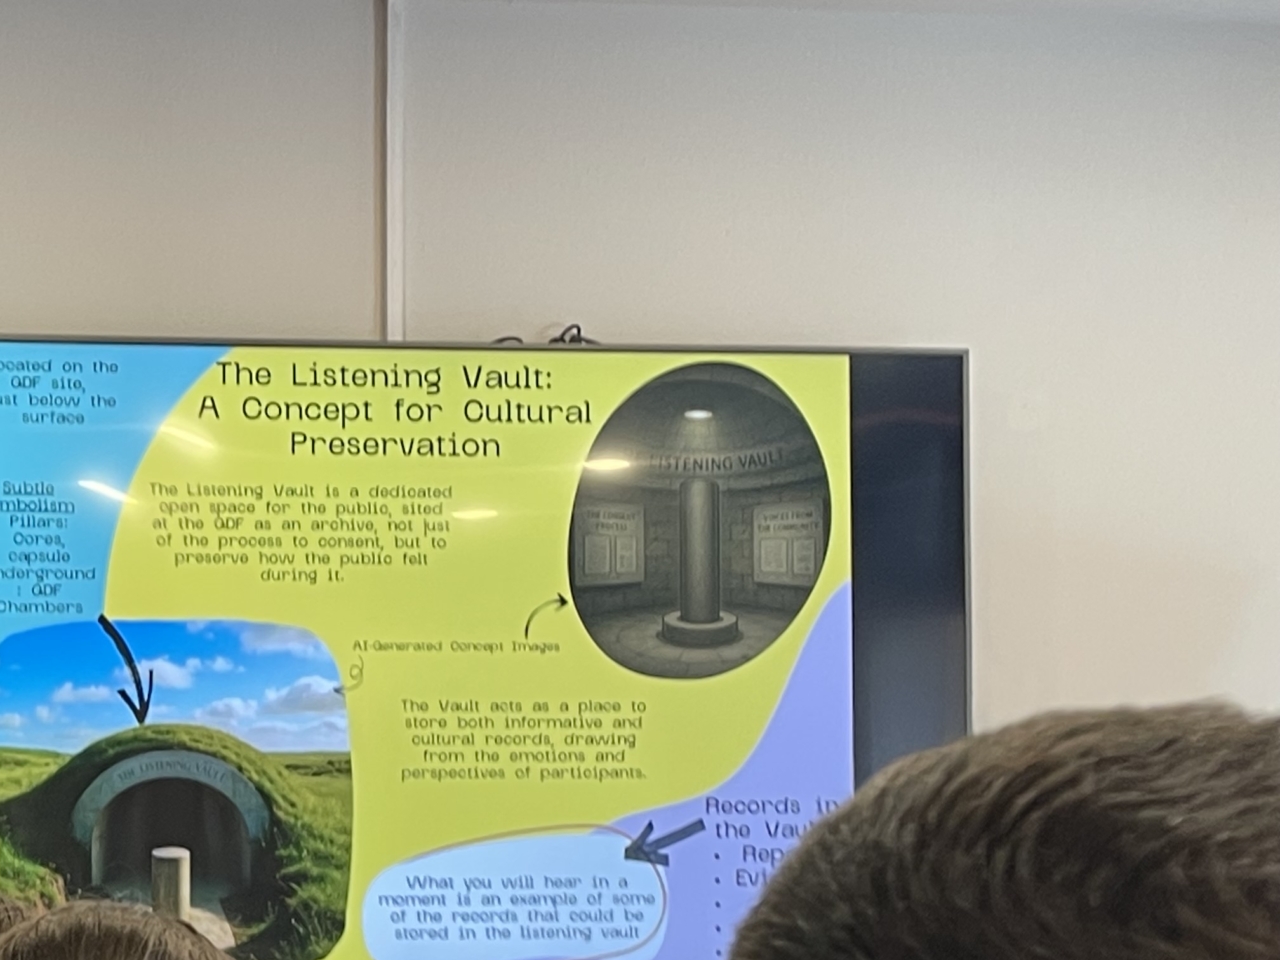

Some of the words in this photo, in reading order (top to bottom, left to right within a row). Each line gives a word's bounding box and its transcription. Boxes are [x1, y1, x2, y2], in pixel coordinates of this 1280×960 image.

[62, 361, 83, 372] on
[93, 361, 119, 373] the
[51, 377, 85, 394] site,
[216, 361, 272, 387] The
[291, 362, 441, 395] Listening
[462, 364, 553, 390] Vault:
[29, 393, 80, 407] below
[91, 395, 116, 407] the
[22, 411, 84, 424] surface
[198, 395, 220, 419] A
[242, 396, 373, 429] Concept
[394, 398, 442, 422] for
[463, 399, 592, 424] Cultural
[291, 431, 501, 457] Preservation
[739, 450, 784, 469] VAULT
[2, 481, 54, 496] Subtle
[150, 482, 178, 496] The
[187, 483, 263, 500] Listening
[273, 484, 314, 497] Vault
[326, 484, 339, 498] is
[350, 487, 359, 498] a
[369, 485, 452, 498] dedicated
[159, 501, 200, 517] open
[210, 502, 255, 517] space
[266, 502, 290, 513] for
[301, 502, 326, 515] the
[336, 502, 392, 518] public,
[402, 502, 443, 515] sited
[10, 515, 68, 528] Pillars:
[153, 518, 168, 530] at
[179, 517, 204, 530] the
[255, 519, 271, 530] as
[281, 520, 301, 530] an
[311, 518, 377, 535] archive,
[388, 520, 413, 531] not
[424, 519, 450, 537] just
[13, 532, 65, 549] Cores,
[156, 533, 172, 547] of
[183, 534, 208, 547] the
[218, 535, 282, 551] process
[293, 536, 308, 548] to
[318, 535, 384, 551] consent,
[394, 535, 421, 548] but
[431, 537, 446, 549] to
[8, 550, 70, 566] capsule
[174, 552, 249, 567] preserve
[259, 551, 295, 564] how
[305, 552, 330, 565] the
[340, 552, 392, 568] public
[403, 552, 428, 565] felt
[261, 569, 317, 585] during
[328, 569, 344, 582] it.
[450, 641, 503, 654] Concept
[512, 641, 560, 654] Images
[401, 699, 429, 712] The
[439, 700, 479, 713] Vault
[490, 701, 522, 713] acts
[533, 702, 549, 713] as
[560, 702, 569, 713] a
[578, 700, 622, 715] place
[632, 701, 646, 713] to
[405, 717, 447, 729] store
[457, 717, 494, 729] both
[505, 716, 602, 729] informative
[613, 717, 642, 729] and
[412, 733, 475, 747] cultural
[485, 734, 554, 748] records,
[564, 733, 636, 748] drawing
[424, 750, 464, 762] from
[474, 751, 499, 763] the
[510, 750, 585, 763] emotions
[595, 751, 625, 763] and
[401, 766, 505, 782] perspectives
[515, 767, 530, 779] of
[540, 767, 646, 782] participants.
[705, 796, 800, 815] Records
[716, 821, 751, 839] the
[406, 876, 454, 890] What
[463, 877, 492, 893] you
[501, 876, 534, 889] will
[544, 876, 582, 889] hear
[592, 876, 609, 889] in
[618, 878, 628, 890] a
[378, 893, 446, 907] moment
[457, 892, 471, 907] is
[481, 894, 501, 907] an
[510, 893, 577, 909] example
[587, 892, 602, 906] of
[613, 894, 655, 906] some
[390, 910, 407, 924] of
[416, 910, 442, 924] the
[452, 910, 518, 924] records
[528, 909, 559, 923] that
[569, 910, 614, 923] could
[624, 910, 644, 923] be
[395, 926, 449, 941] stored
[459, 926, 476, 940] in
[485, 926, 511, 940] the
[520, 926, 592, 943] listening
[602, 926, 640, 940] vault
